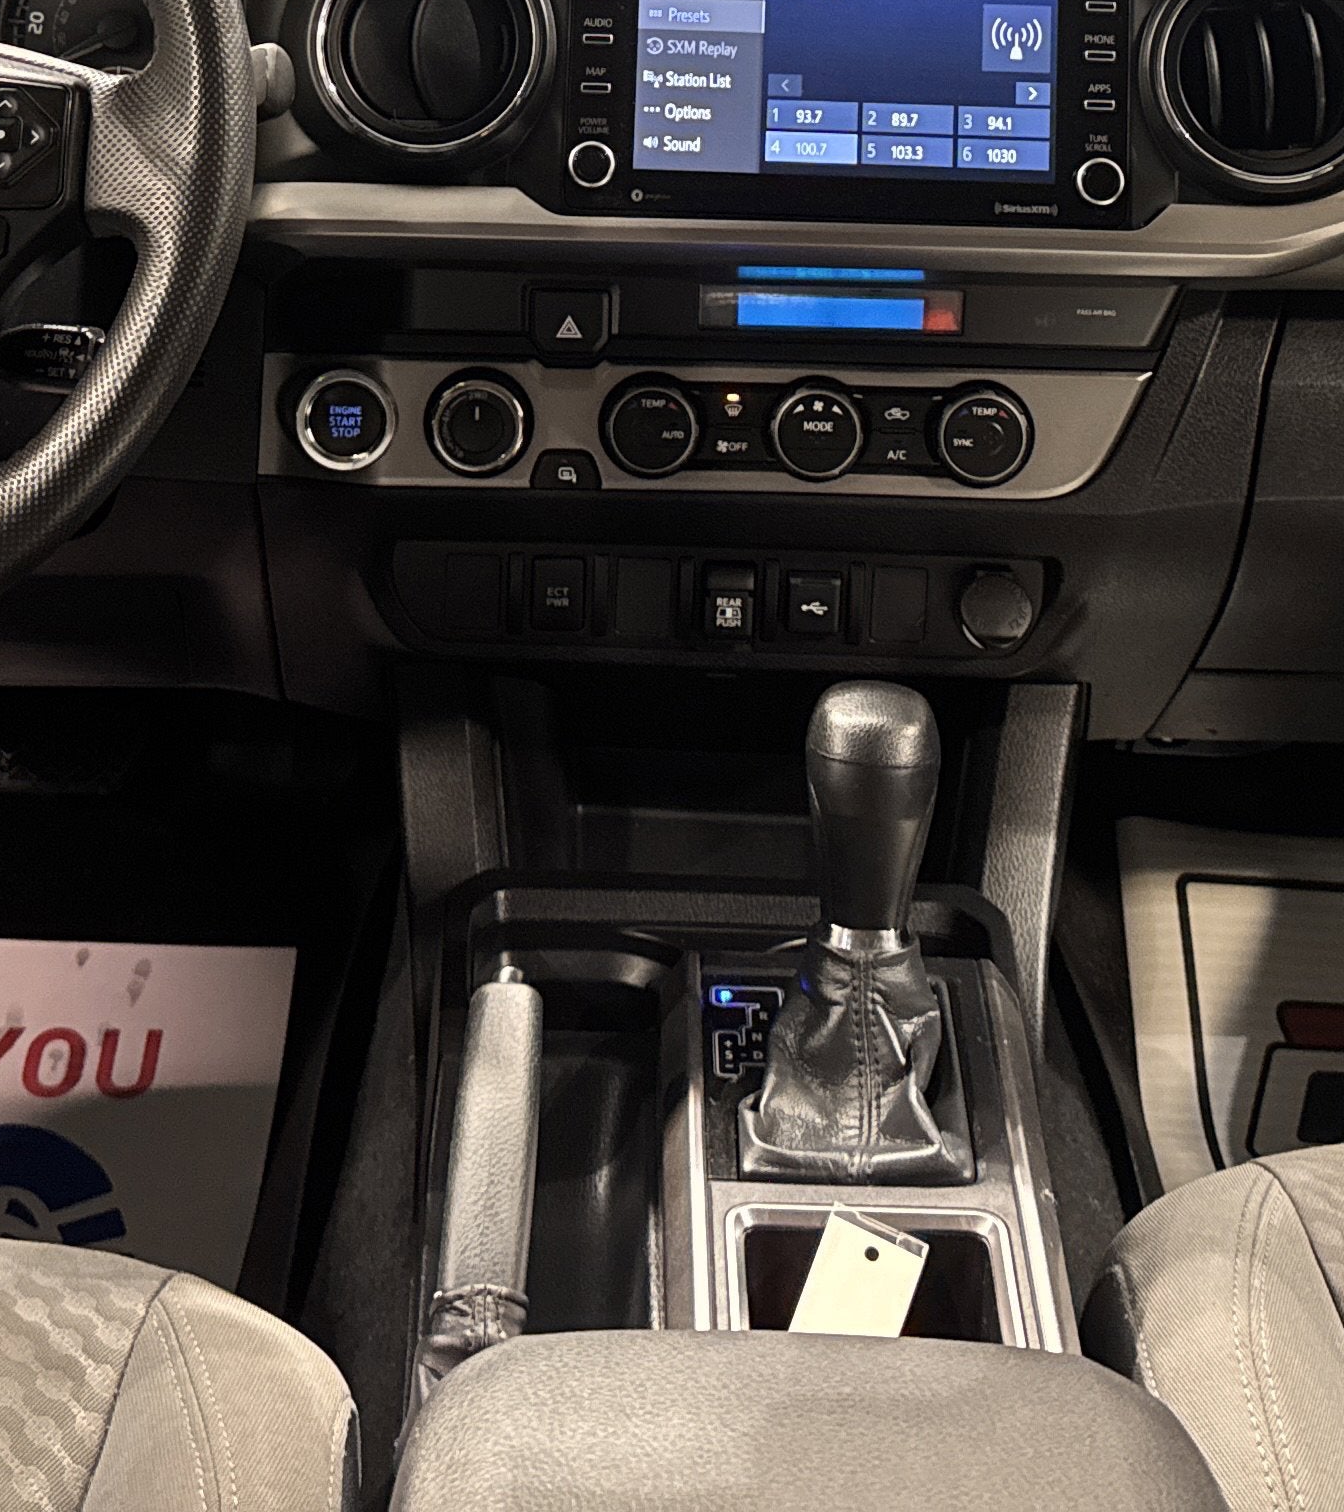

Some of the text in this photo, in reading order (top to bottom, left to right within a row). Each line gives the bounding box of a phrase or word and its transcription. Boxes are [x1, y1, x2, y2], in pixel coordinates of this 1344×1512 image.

[668, 7, 710, 24] Presets
[28, 11, 45, 35] 20
[584, 18, 613, 28] AUDIO
[1084, 35, 1115, 45] PHONE
[667, 39, 738, 60] SXM Replay
[586, 67, 607, 76] MAP
[665, 70, 732, 89] Station List
[1088, 83, 1112, 94] APPS
[664, 103, 712, 122] Options
[772, 108, 823, 124] 1 93.7
[867, 111, 919, 127] 2 89.7
[963, 114, 1012, 130] 3 94.1
[663, 135, 701, 153] Sound
[770, 140, 827, 156] 4 100.7
[866, 143, 923, 160] 5 103.3
[963, 146, 1017, 164] 6 1030
[53, 334, 72, 344] RES
[641, 399, 666, 407] TEMP
[329, 406, 362, 415] ENGINE
[972, 407, 997, 416] TEMP
[329, 417, 362, 426] START
[803, 421, 834, 432] MODE
[331, 428, 361, 437] STOP
[661, 431, 684, 439] AUTO
[728, 442, 748, 451] OFF
[953, 438, 974, 447] SYNC
[887, 449, 907, 460] A/C
[546, 587, 569, 597] ECT
[546, 598, 569, 607] PWR
[716, 597, 742, 607] REAR
[716, 618, 742, 628] PUSH
[752, 1050, 764, 1060] D
